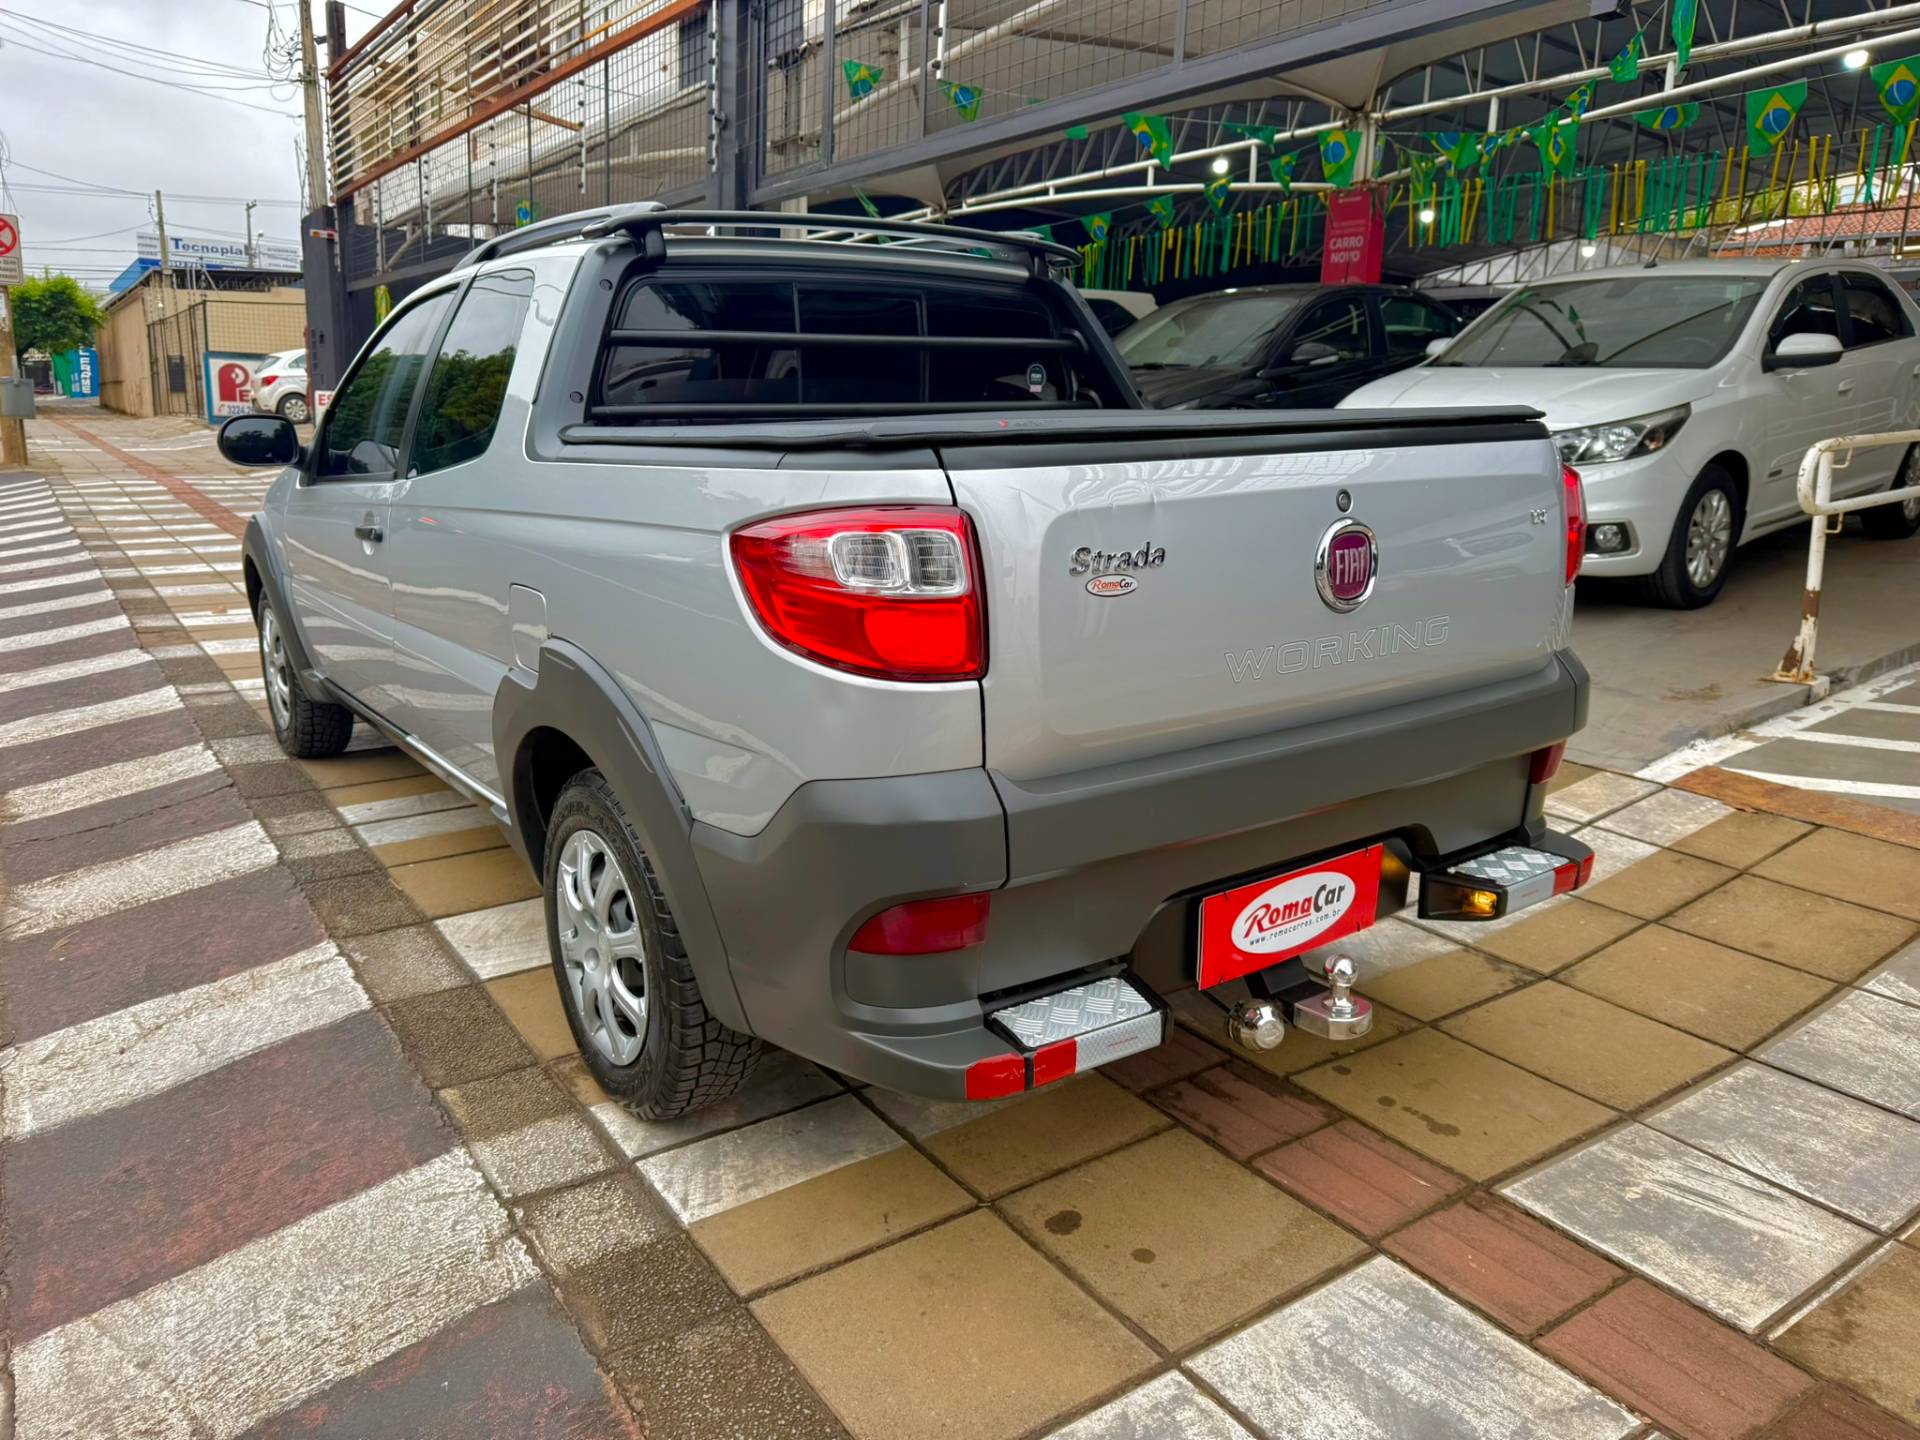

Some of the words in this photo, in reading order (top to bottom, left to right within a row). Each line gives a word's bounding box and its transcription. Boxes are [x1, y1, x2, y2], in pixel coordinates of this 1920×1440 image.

[1329, 235, 1364, 249] CARRO
[1330, 251, 1360, 263] NOVO
[1069, 541, 1166, 577] Strada
[1335, 547, 1367, 585] FIAT
[1223, 615, 1450, 683] WORKING
[1243, 883, 1345, 938] RomaCar
